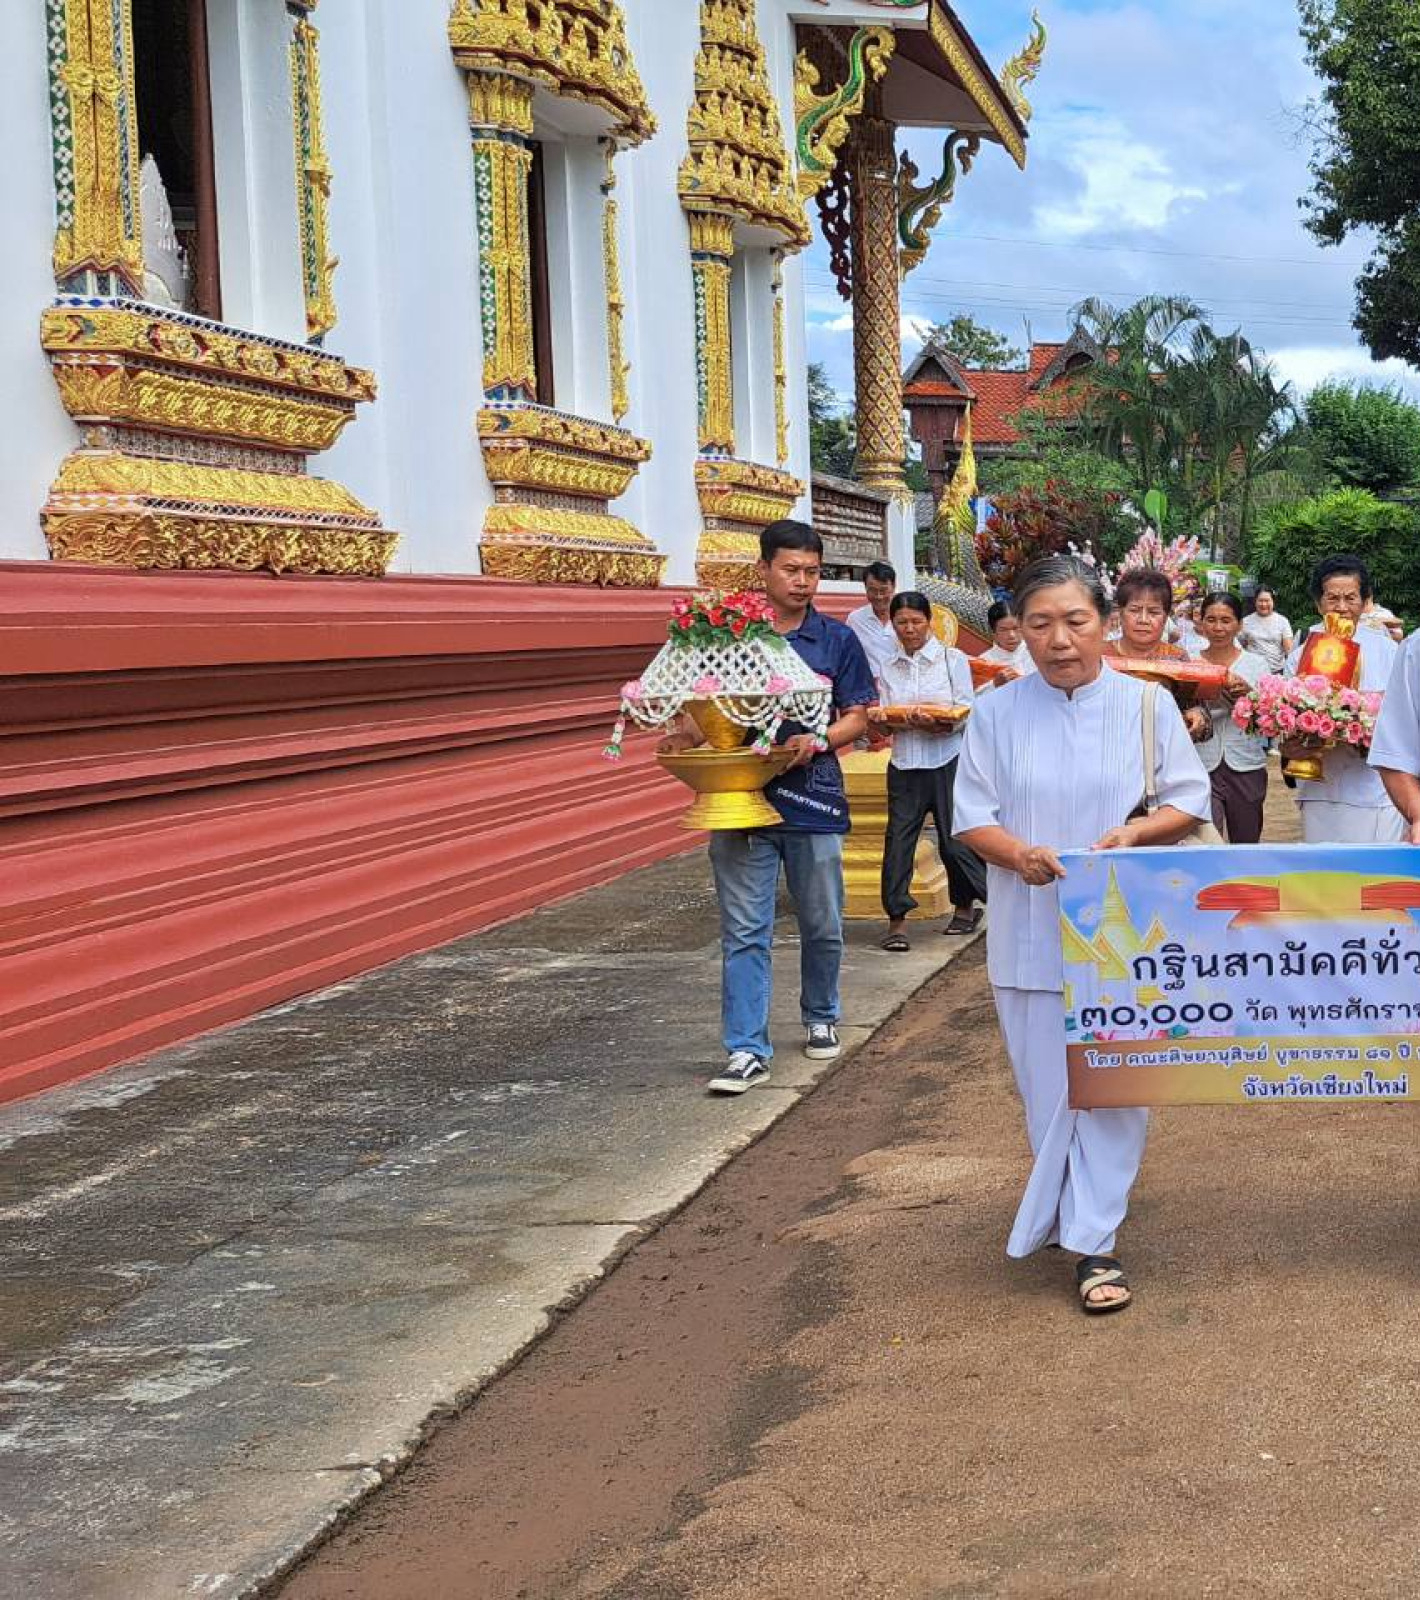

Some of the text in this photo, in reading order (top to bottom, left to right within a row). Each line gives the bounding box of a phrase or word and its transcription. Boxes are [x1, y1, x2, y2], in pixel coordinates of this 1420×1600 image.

[1081, 1002, 1234, 1031] ๓๐,๐๐๐
[1246, 998, 1278, 1021] วัด
[1086, 1050, 1121, 1067] โดย
[1128, 1043, 1268, 1067] คณะศิษยานุศิษย์
[1275, 1047, 1360, 1067] บูชาธรรม
[1366, 1047, 1391, 1061] ๘๑
[1398, 1042, 1411, 1060] ปี
[1242, 1071, 1408, 1097] จังหวัดเชียงใหม่
